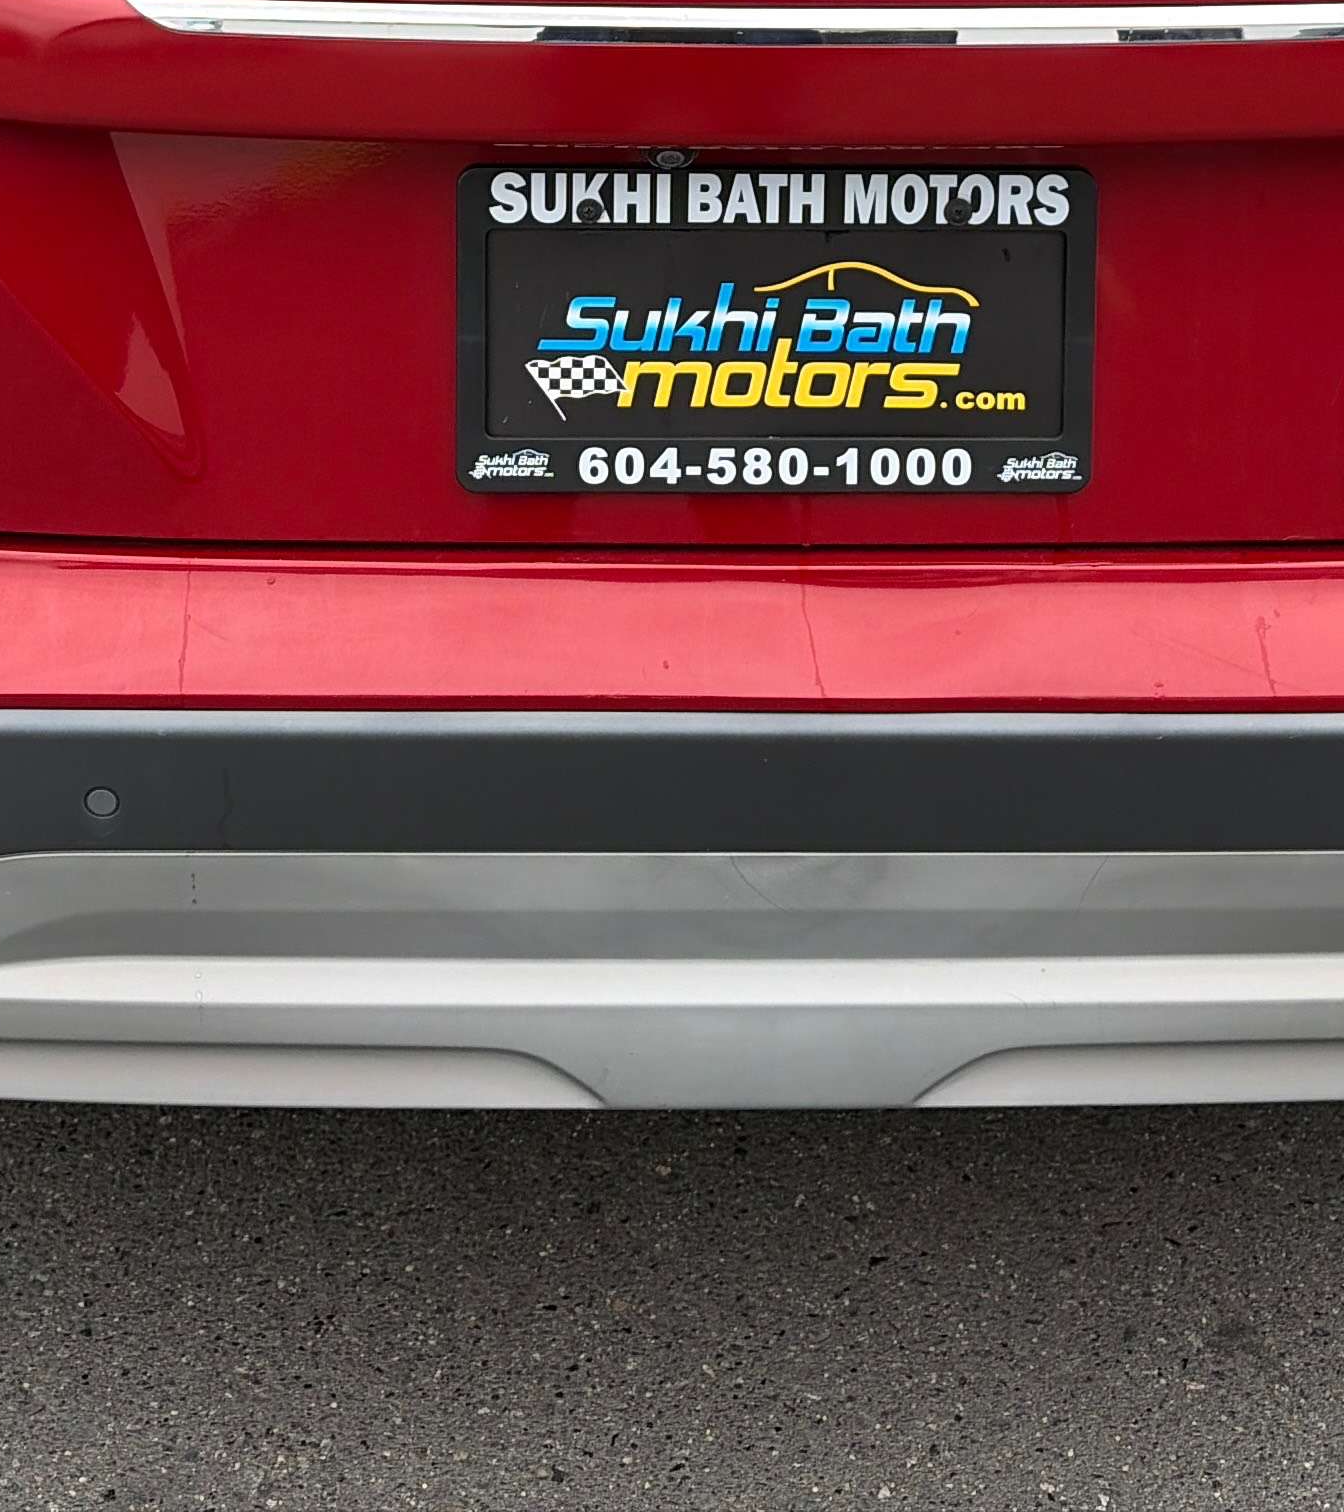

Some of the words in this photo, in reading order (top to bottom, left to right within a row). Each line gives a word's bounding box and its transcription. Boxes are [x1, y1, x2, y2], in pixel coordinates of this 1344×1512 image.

[488, 171, 672, 224] SUKHI
[687, 173, 826, 224] BATH
[843, 173, 1070, 226] MOTORS
[538, 282, 779, 352] Sukhi
[796, 299, 972, 354] Bath
[578, 446, 973, 486] 604-580-1000
